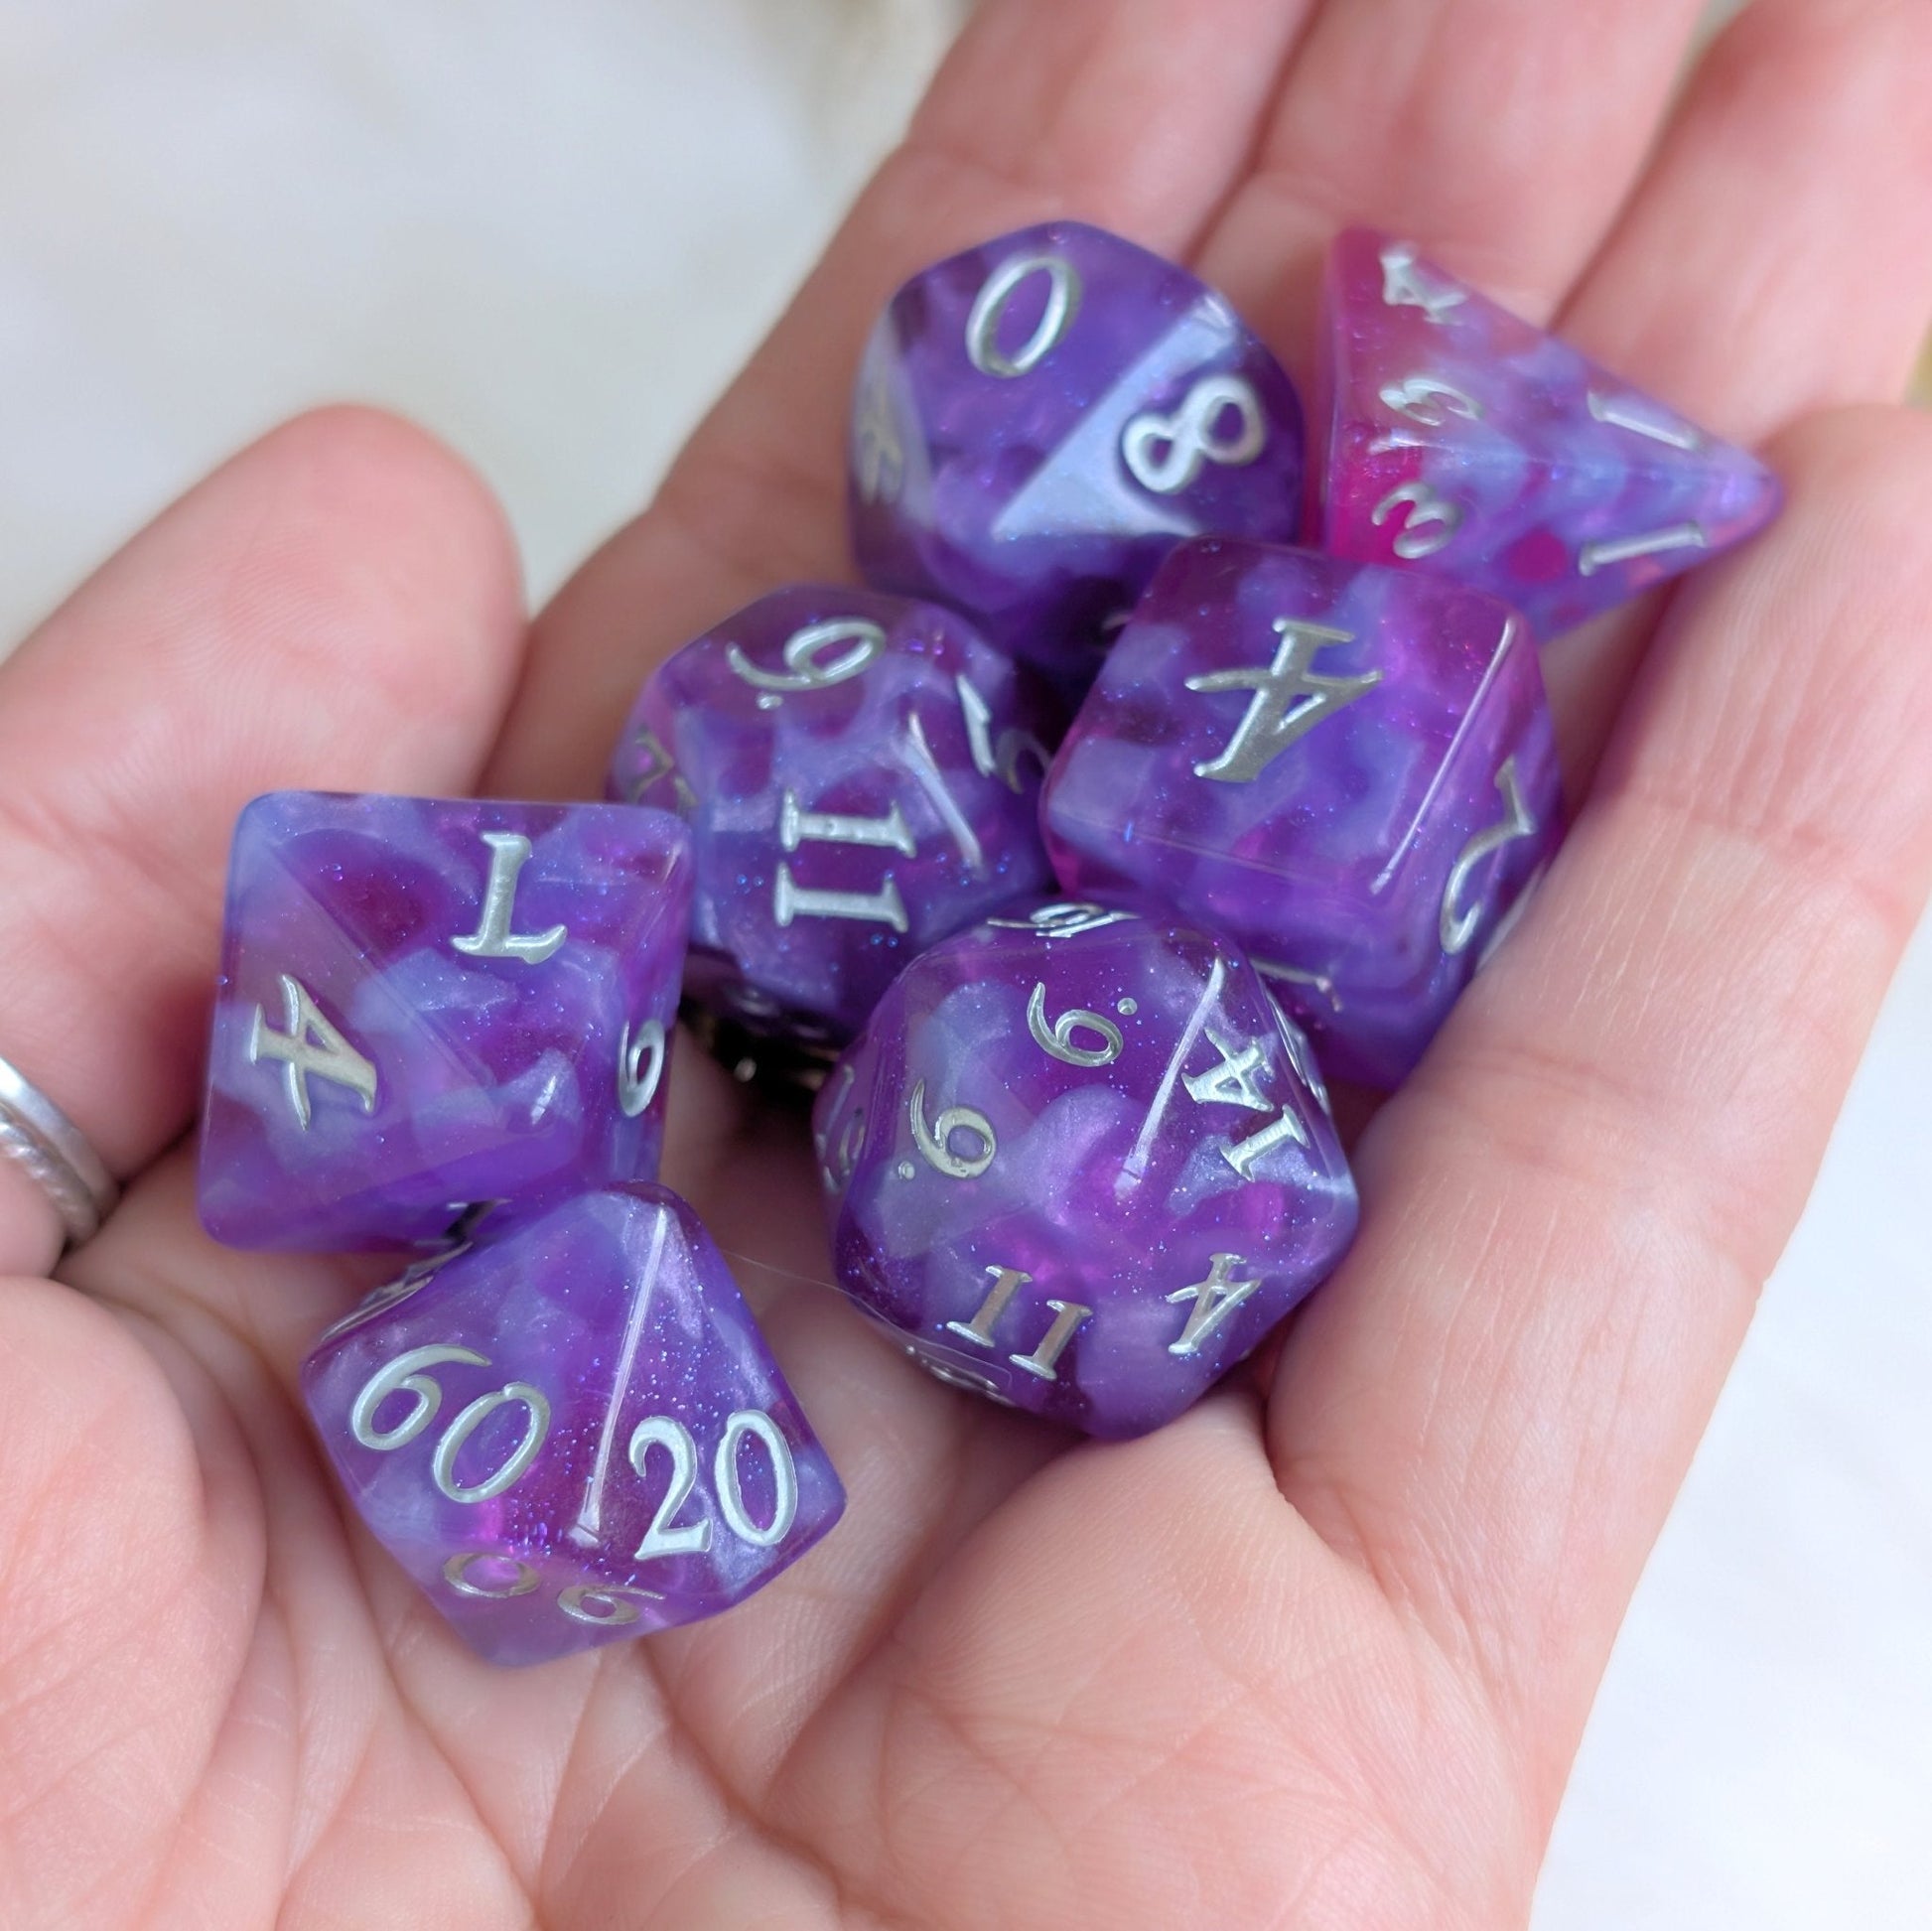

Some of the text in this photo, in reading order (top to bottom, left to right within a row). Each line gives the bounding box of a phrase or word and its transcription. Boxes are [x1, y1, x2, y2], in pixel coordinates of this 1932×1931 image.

[966, 257, 1081, 376] 0
[1123, 376, 1266, 493] 8
[1372, 483, 1464, 559] 3
[1185, 619, 1383, 782] 4
[775, 792, 916, 932] 11
[249, 974, 377, 1132] 4
[1181, 1028, 1311, 1182] 14
[946, 1265, 1093, 1380] 11
[1166, 1252, 1262, 1355] 4
[351, 1343, 552, 1503] 60
[628, 1409, 797, 1560] 20
